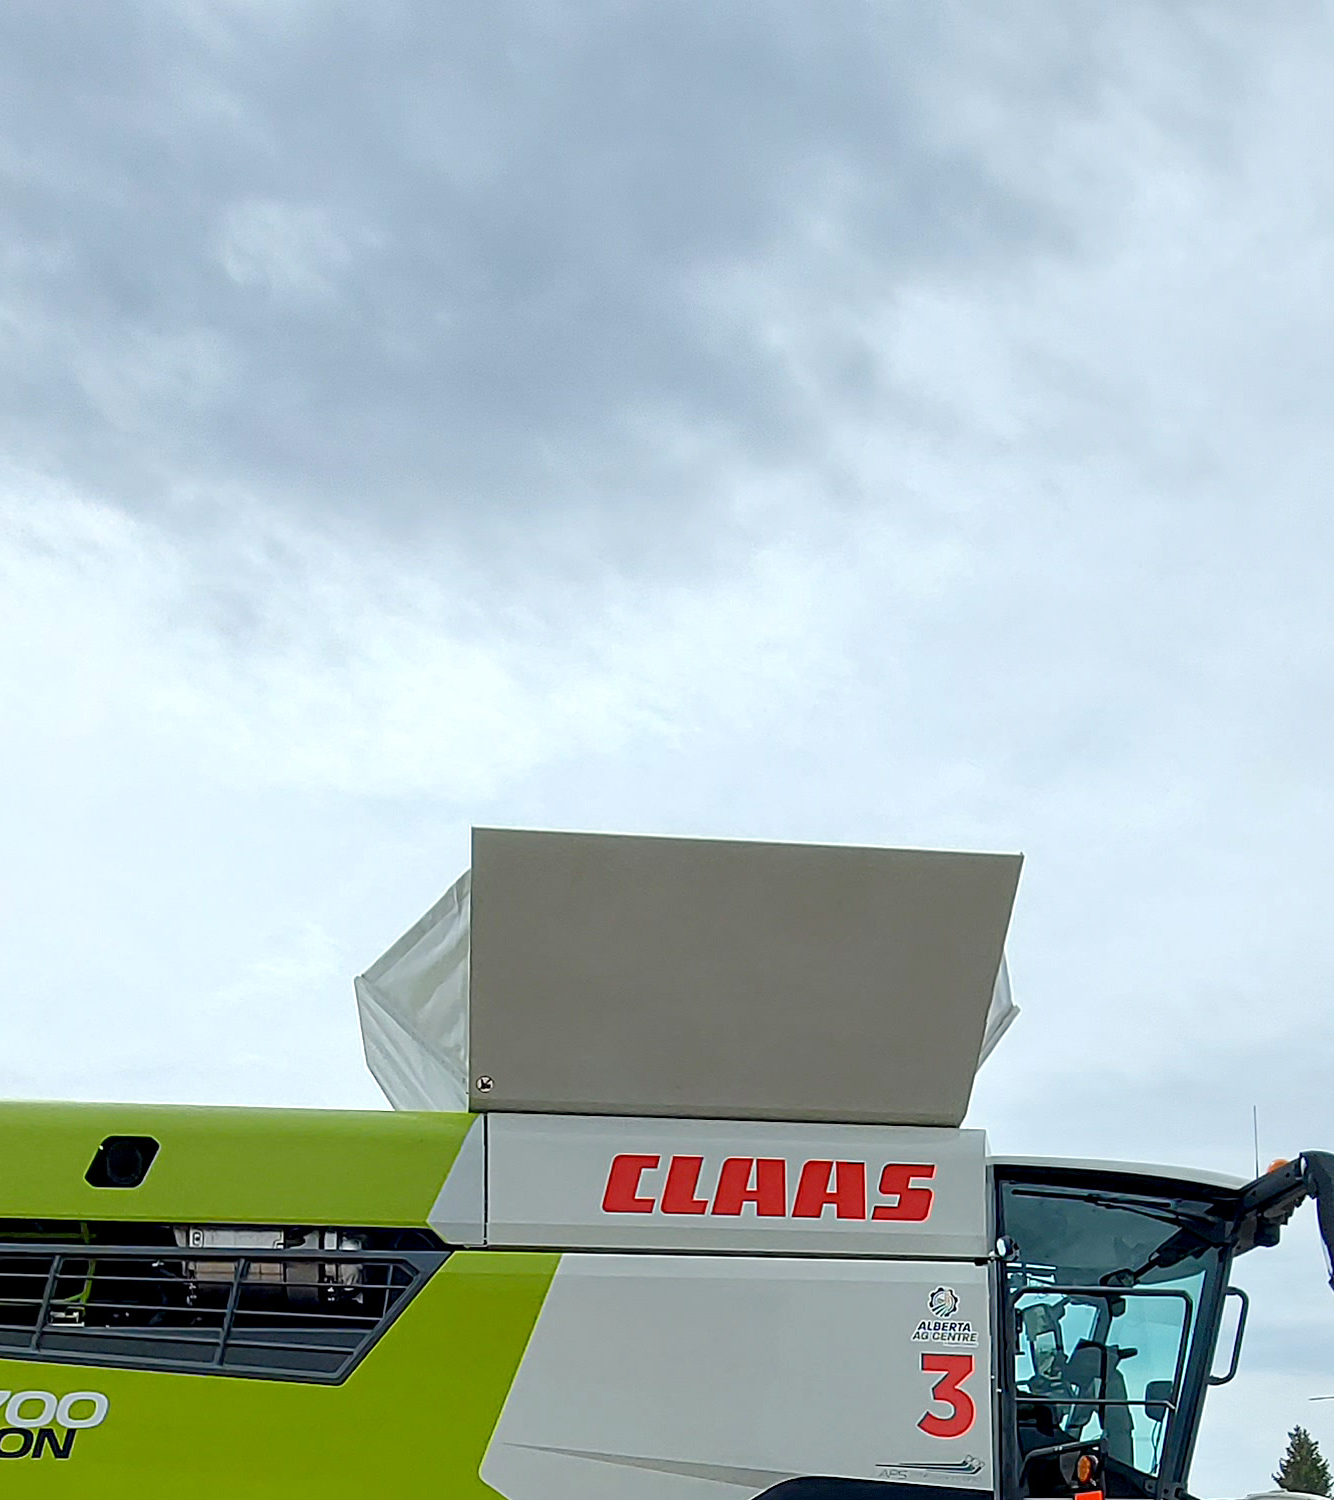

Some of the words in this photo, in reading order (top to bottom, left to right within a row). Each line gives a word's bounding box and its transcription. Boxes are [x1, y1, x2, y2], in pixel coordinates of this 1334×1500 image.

[601, 1153, 937, 1223] CLAAS
[912, 1331, 930, 1341] AG
[932, 1332, 978, 1342] CENTRE
[917, 1321, 972, 1333] ALBERTA
[915, 1352, 976, 1439] 3
